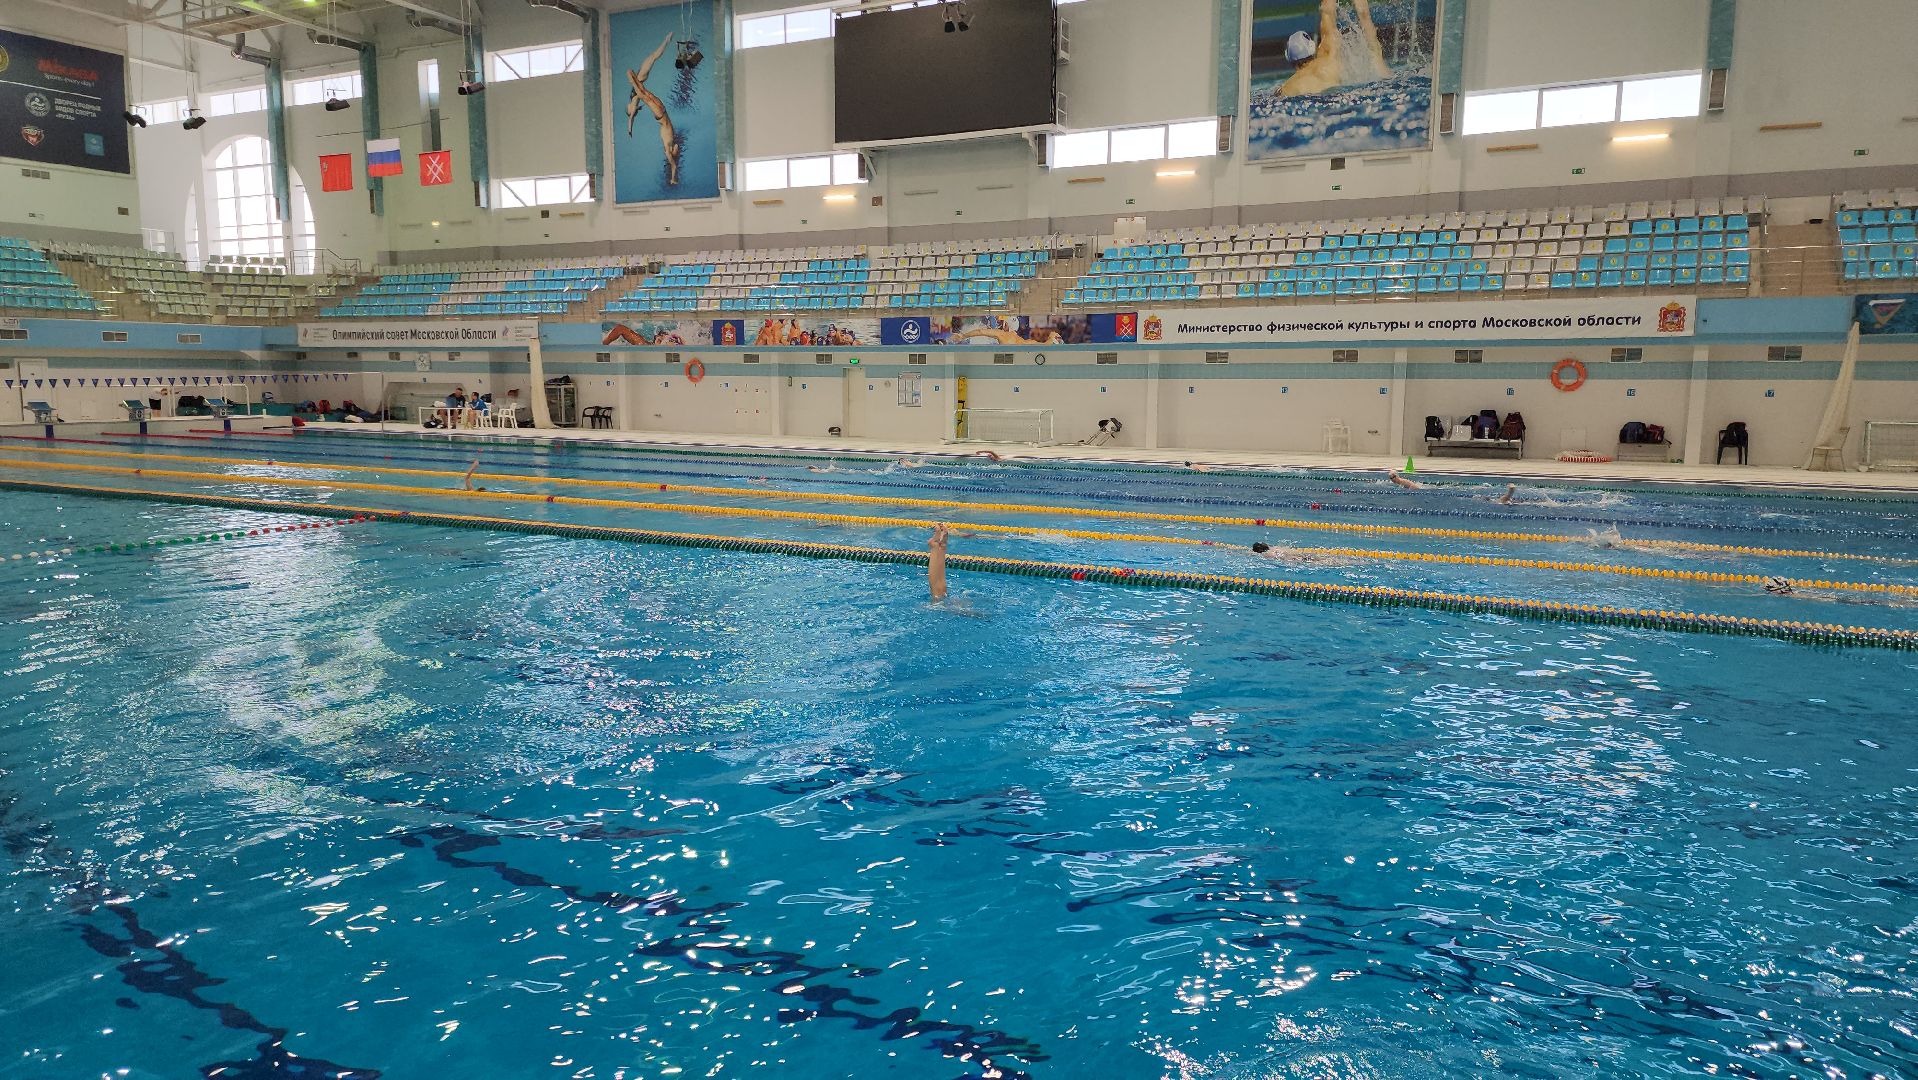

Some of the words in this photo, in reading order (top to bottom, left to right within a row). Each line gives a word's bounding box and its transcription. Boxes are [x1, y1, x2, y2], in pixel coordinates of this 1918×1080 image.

[1178, 323, 1263, 336] Министерство
[1266, 319, 1344, 335] физической
[1348, 319, 1410, 333] культуры
[1415, 320, 1424, 329] и
[1428, 317, 1477, 331] спорта
[1482, 314, 1572, 328] Московской
[1577, 313, 1642, 327] области
[332, 329, 385, 341] Олимпийский
[386, 330, 408, 340] совет
[410, 328, 459, 340] Московской
[461, 328, 497, 340] Области
